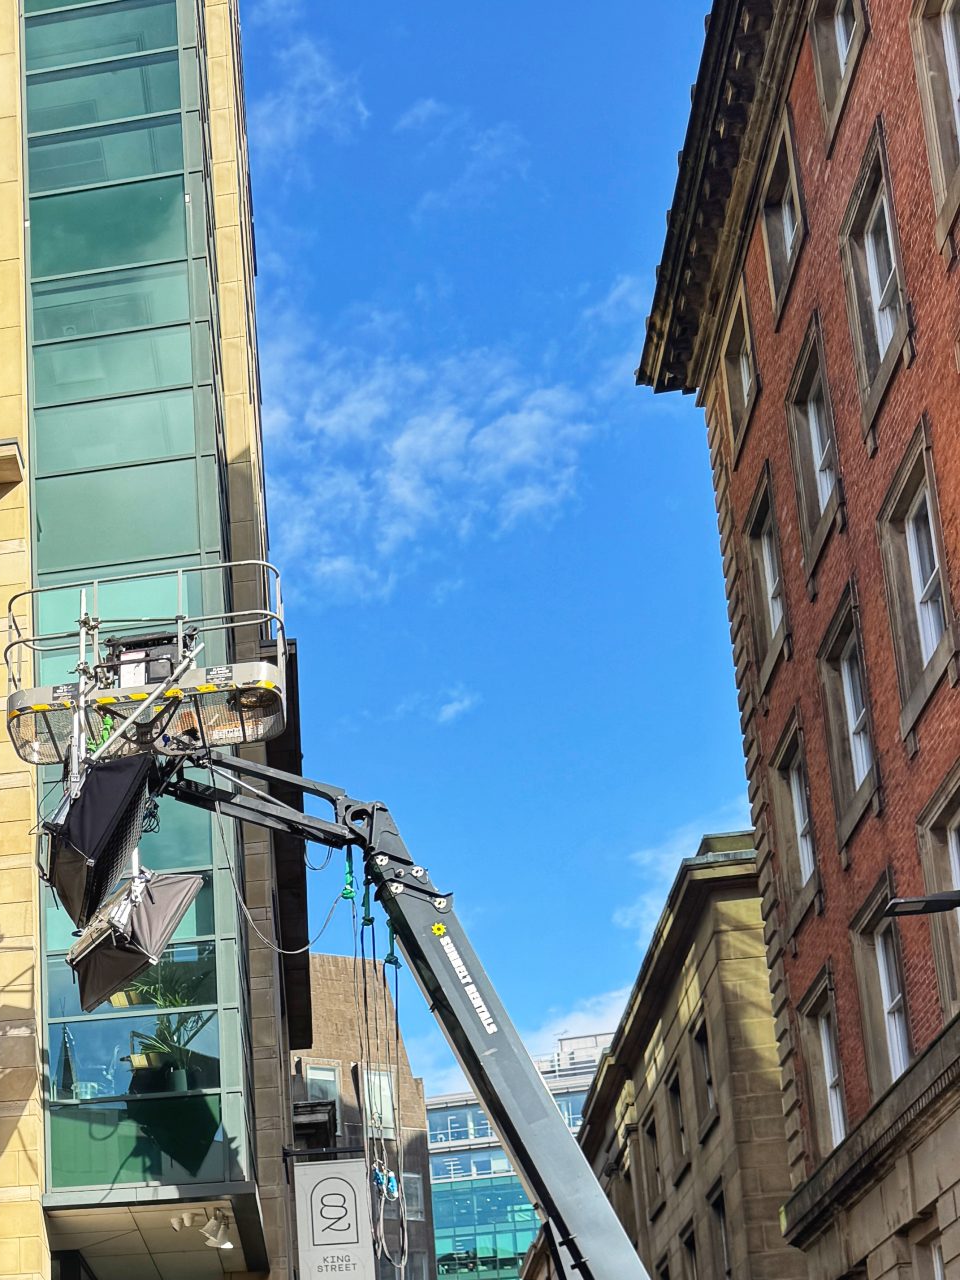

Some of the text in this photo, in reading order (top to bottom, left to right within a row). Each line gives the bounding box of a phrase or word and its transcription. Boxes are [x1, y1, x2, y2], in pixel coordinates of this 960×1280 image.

[440, 935, 498, 1035] SUNBELT RENTALS
[323, 1254, 351, 1264] KING
[317, 1263, 357, 1273] STREET
